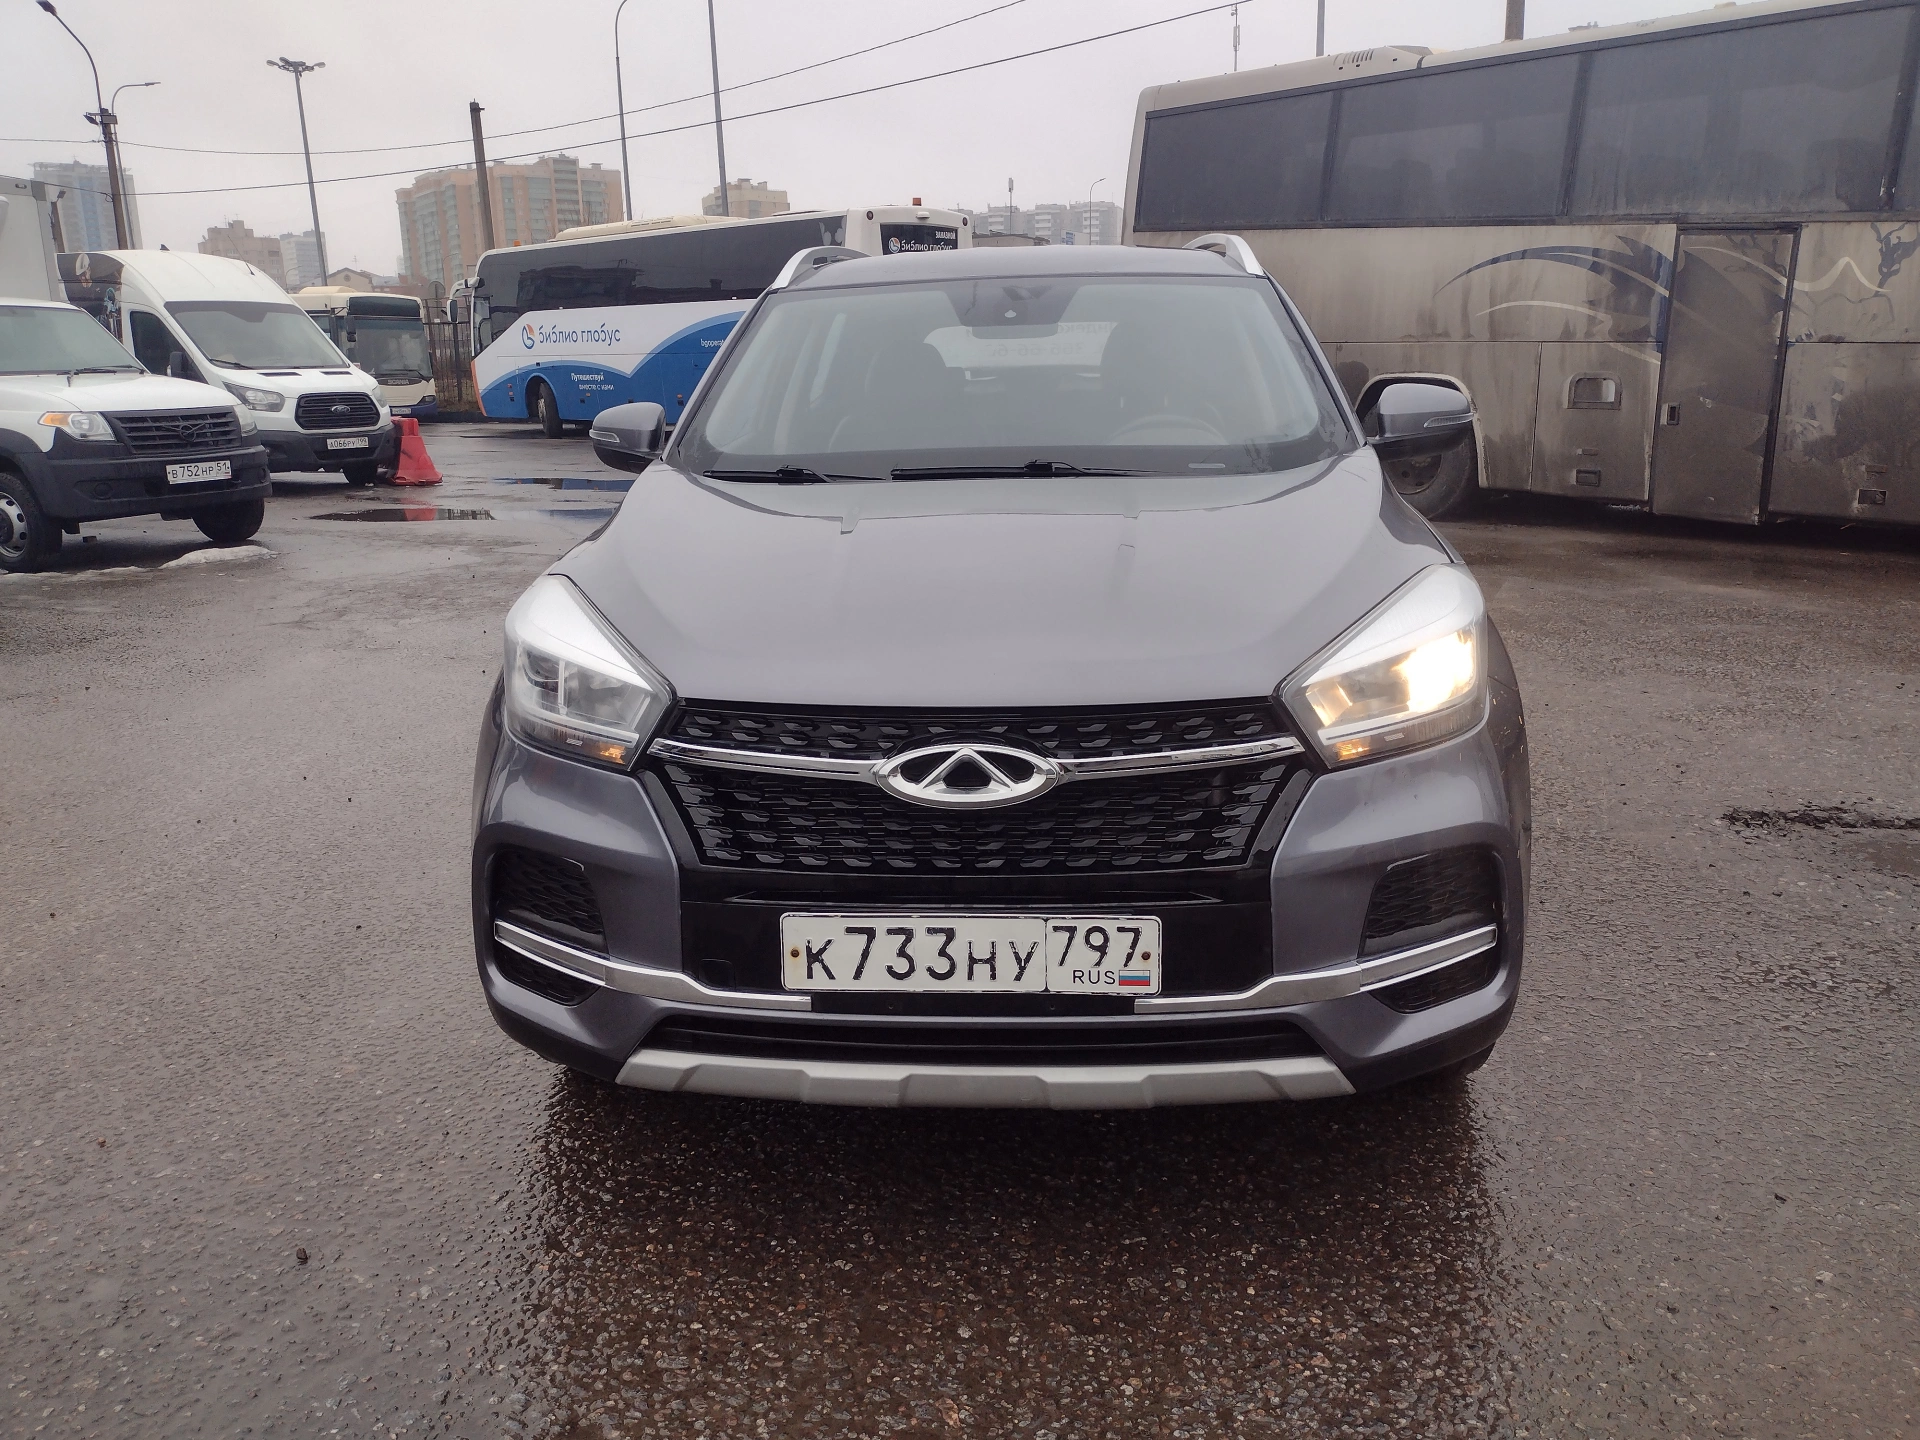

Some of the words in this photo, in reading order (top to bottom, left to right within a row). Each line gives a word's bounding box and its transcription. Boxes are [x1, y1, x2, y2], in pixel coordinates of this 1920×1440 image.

[901, 240, 929, 251] библио
[538, 324, 578, 344] библио
[580, 322, 621, 347] глобус
[570, 372, 605, 382] Путешествуй
[171, 464, 214, 479] В752НР
[216, 462, 227, 472] 51
[804, 925, 1040, 983] К733НУ
[1051, 924, 1143, 969] 797
[1072, 969, 1116, 985] RUS
